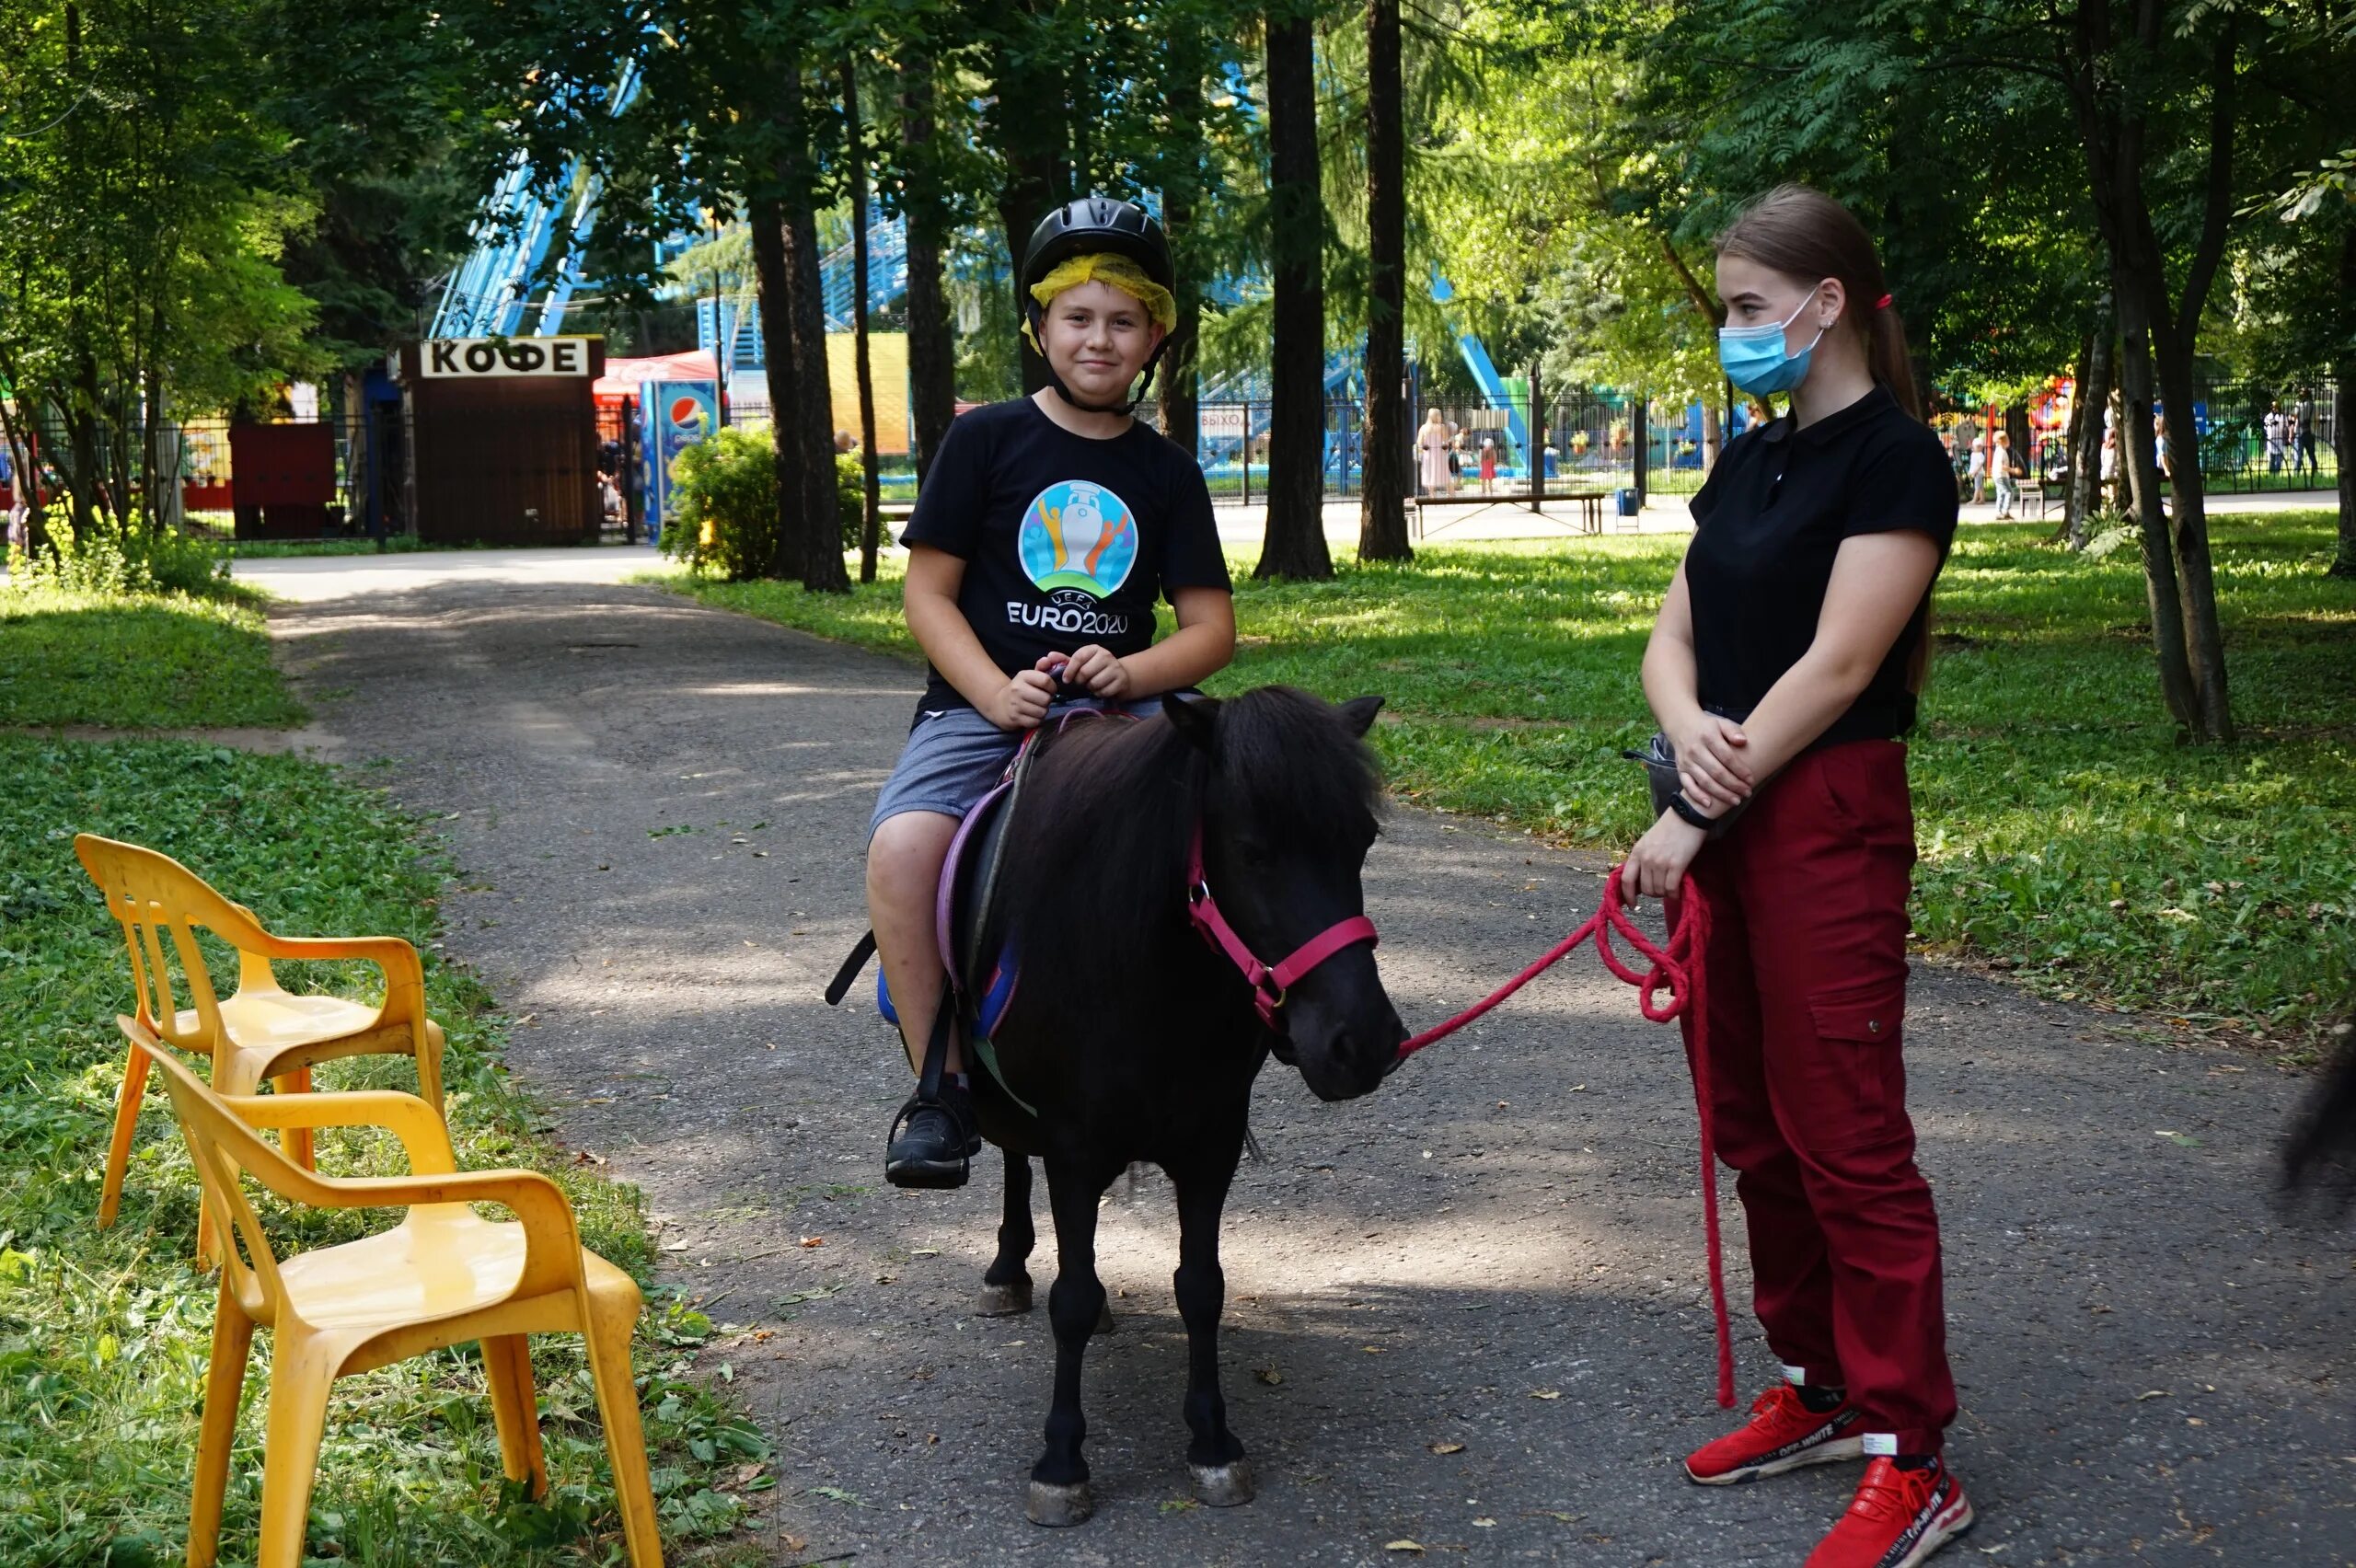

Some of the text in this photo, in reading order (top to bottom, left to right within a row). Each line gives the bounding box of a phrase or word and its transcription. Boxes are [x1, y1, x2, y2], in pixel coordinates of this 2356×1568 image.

[433, 342, 577, 372] КОФЕ
[1051, 593, 1092, 609] UEFA
[1778, 1424, 1834, 1457] OFF-WHITE
